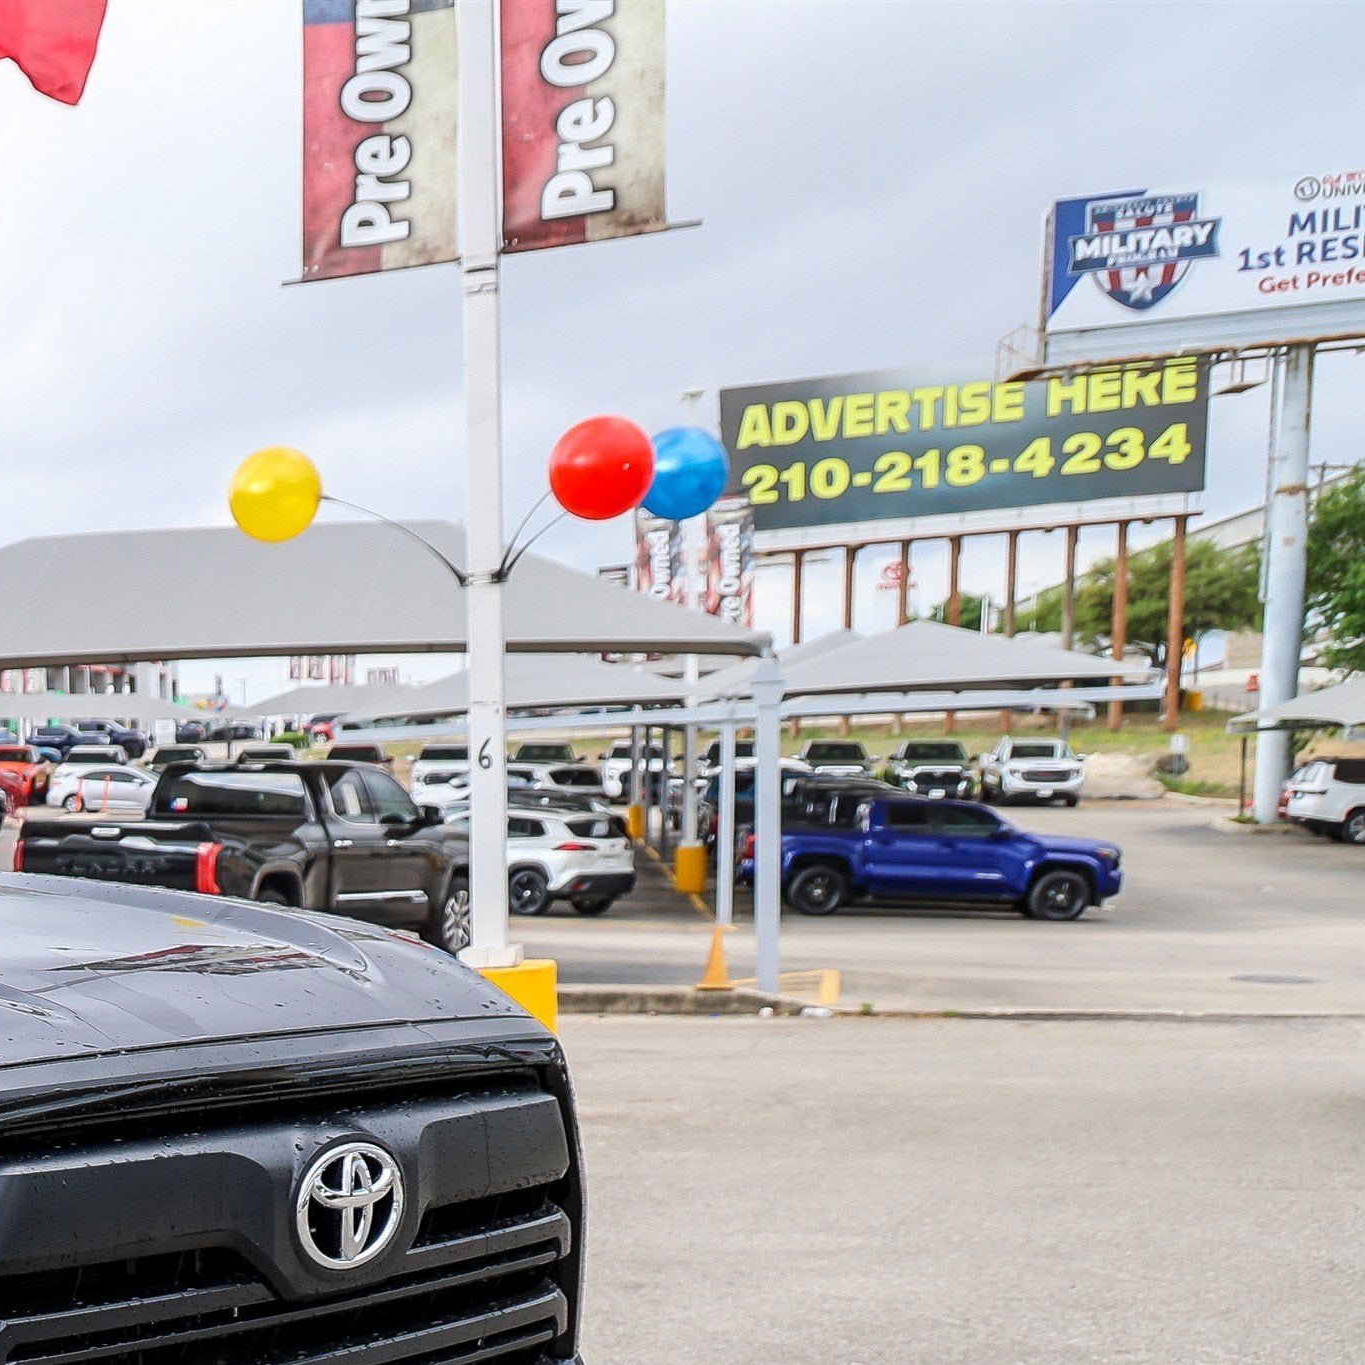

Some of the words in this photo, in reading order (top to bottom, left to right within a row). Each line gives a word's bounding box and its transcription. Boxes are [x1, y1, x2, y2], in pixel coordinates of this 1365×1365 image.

[539, 96, 616, 222] Pre
[339, 134, 412, 249] Pre
[1322, 182, 1365, 199] UNIV
[1287, 203, 1365, 238] MILI
[1074, 222, 1215, 261] MILITARY
[1237, 246, 1286, 272] 1st
[1296, 234, 1365, 266] RES
[1258, 275, 1299, 293] Get
[736, 381, 1025, 450] ADVERTISE
[741, 422, 1192, 505] 210-218-4234
[478, 735, 494, 770] 6
